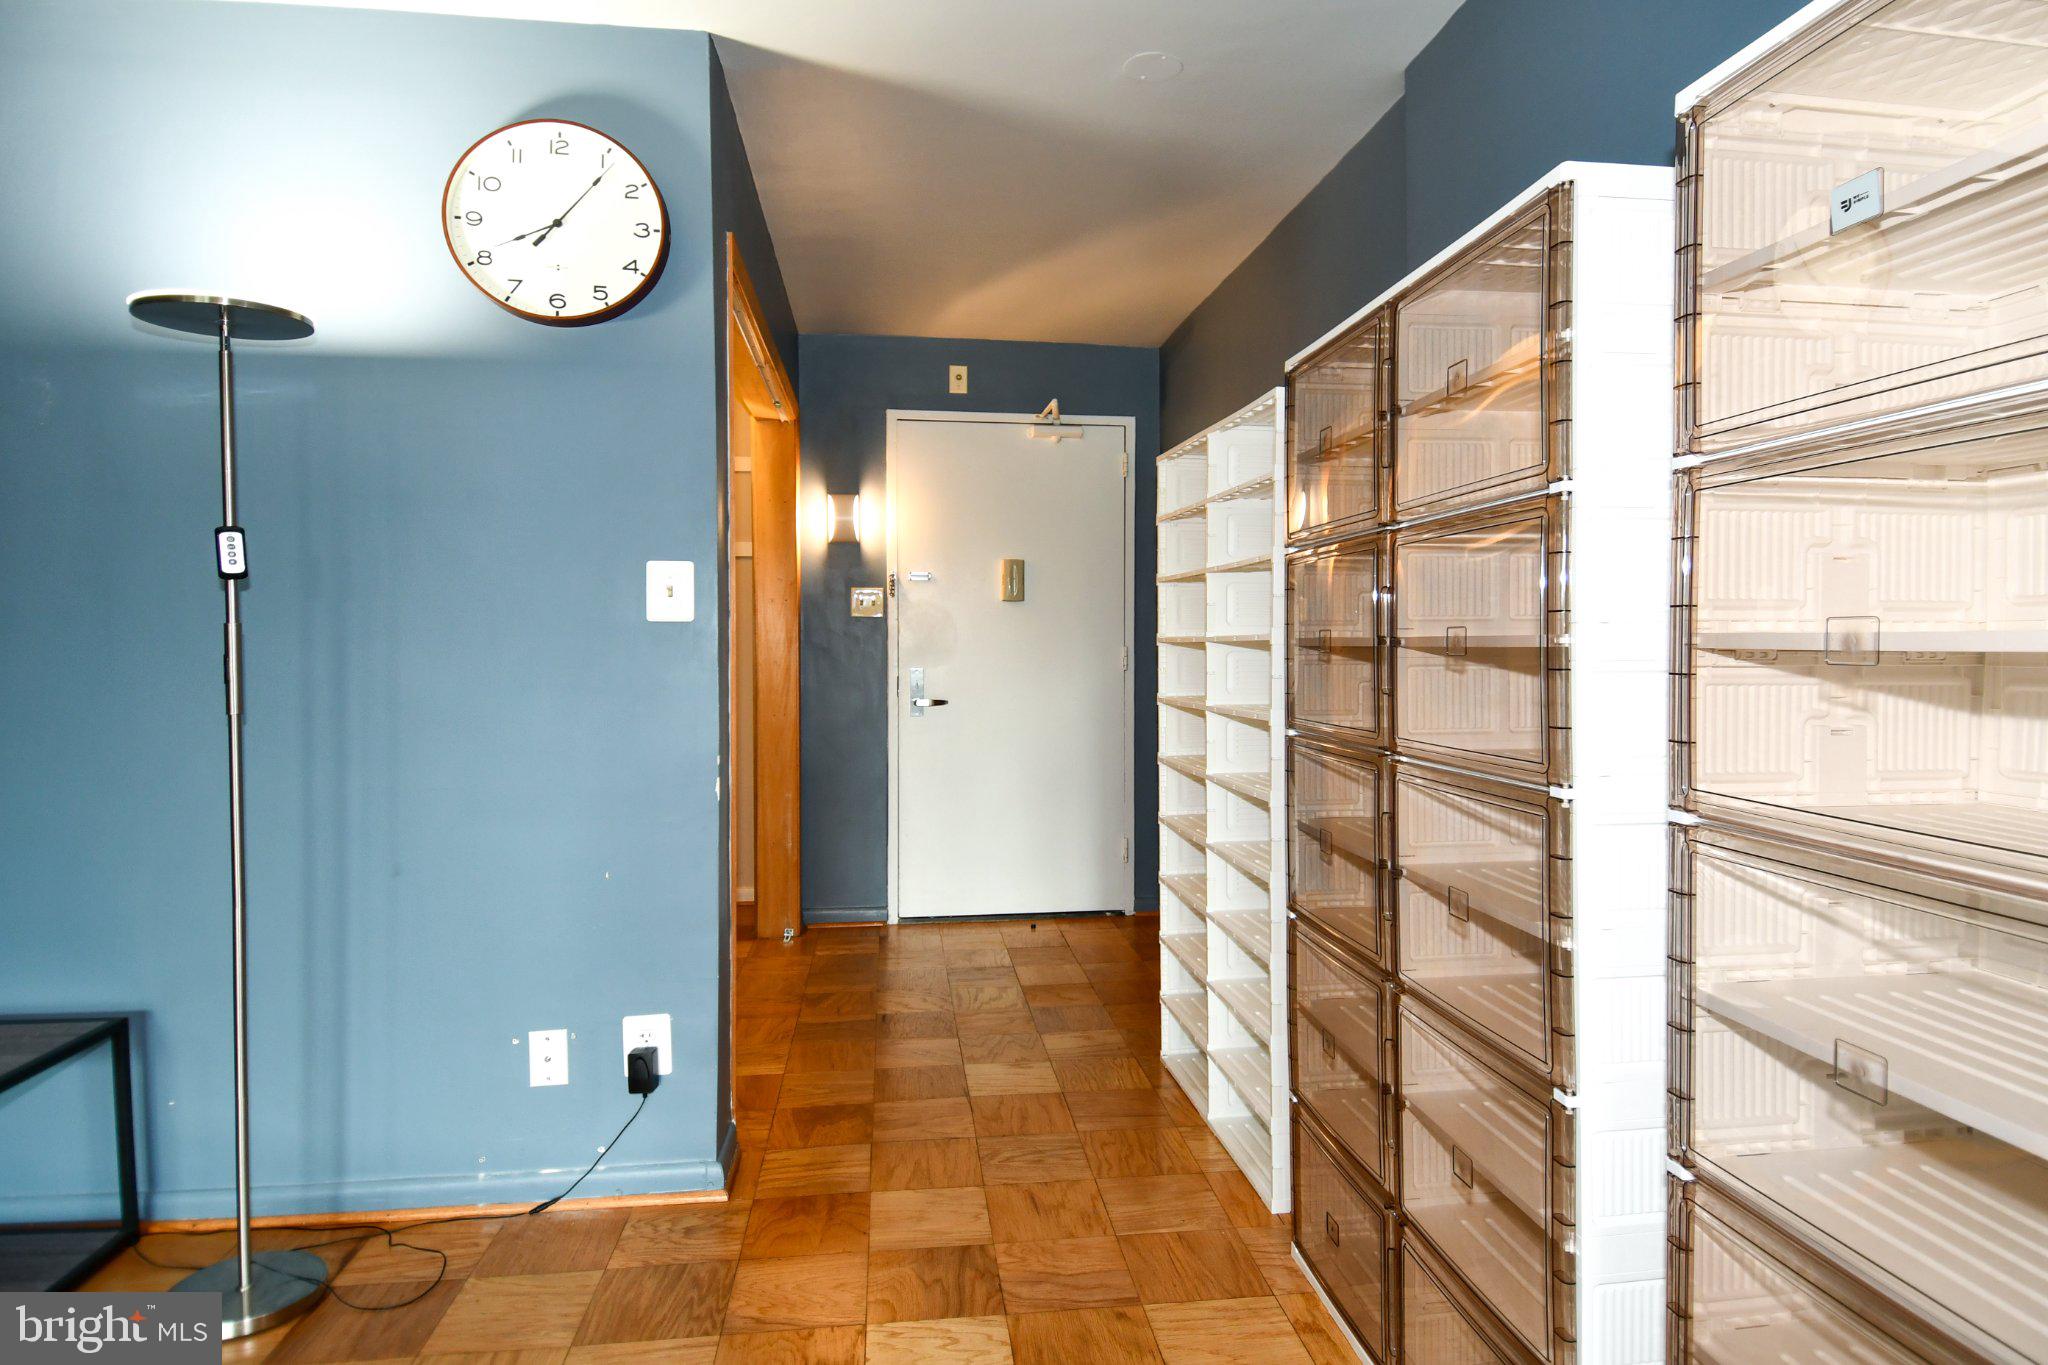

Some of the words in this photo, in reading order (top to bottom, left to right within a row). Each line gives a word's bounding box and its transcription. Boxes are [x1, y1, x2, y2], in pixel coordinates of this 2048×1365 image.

[550, 139, 569, 155] 12
[512, 149, 522, 163] 11
[478, 176, 501, 191] 10
[624, 184, 639, 199] 2
[465, 211, 483, 226] 9
[633, 223, 650, 238] 3
[476, 250, 492, 265] 8
[622, 260, 639, 274] 4
[507, 279, 523, 294] 7
[592, 285, 608, 300] 5
[549, 293, 566, 309] 6
